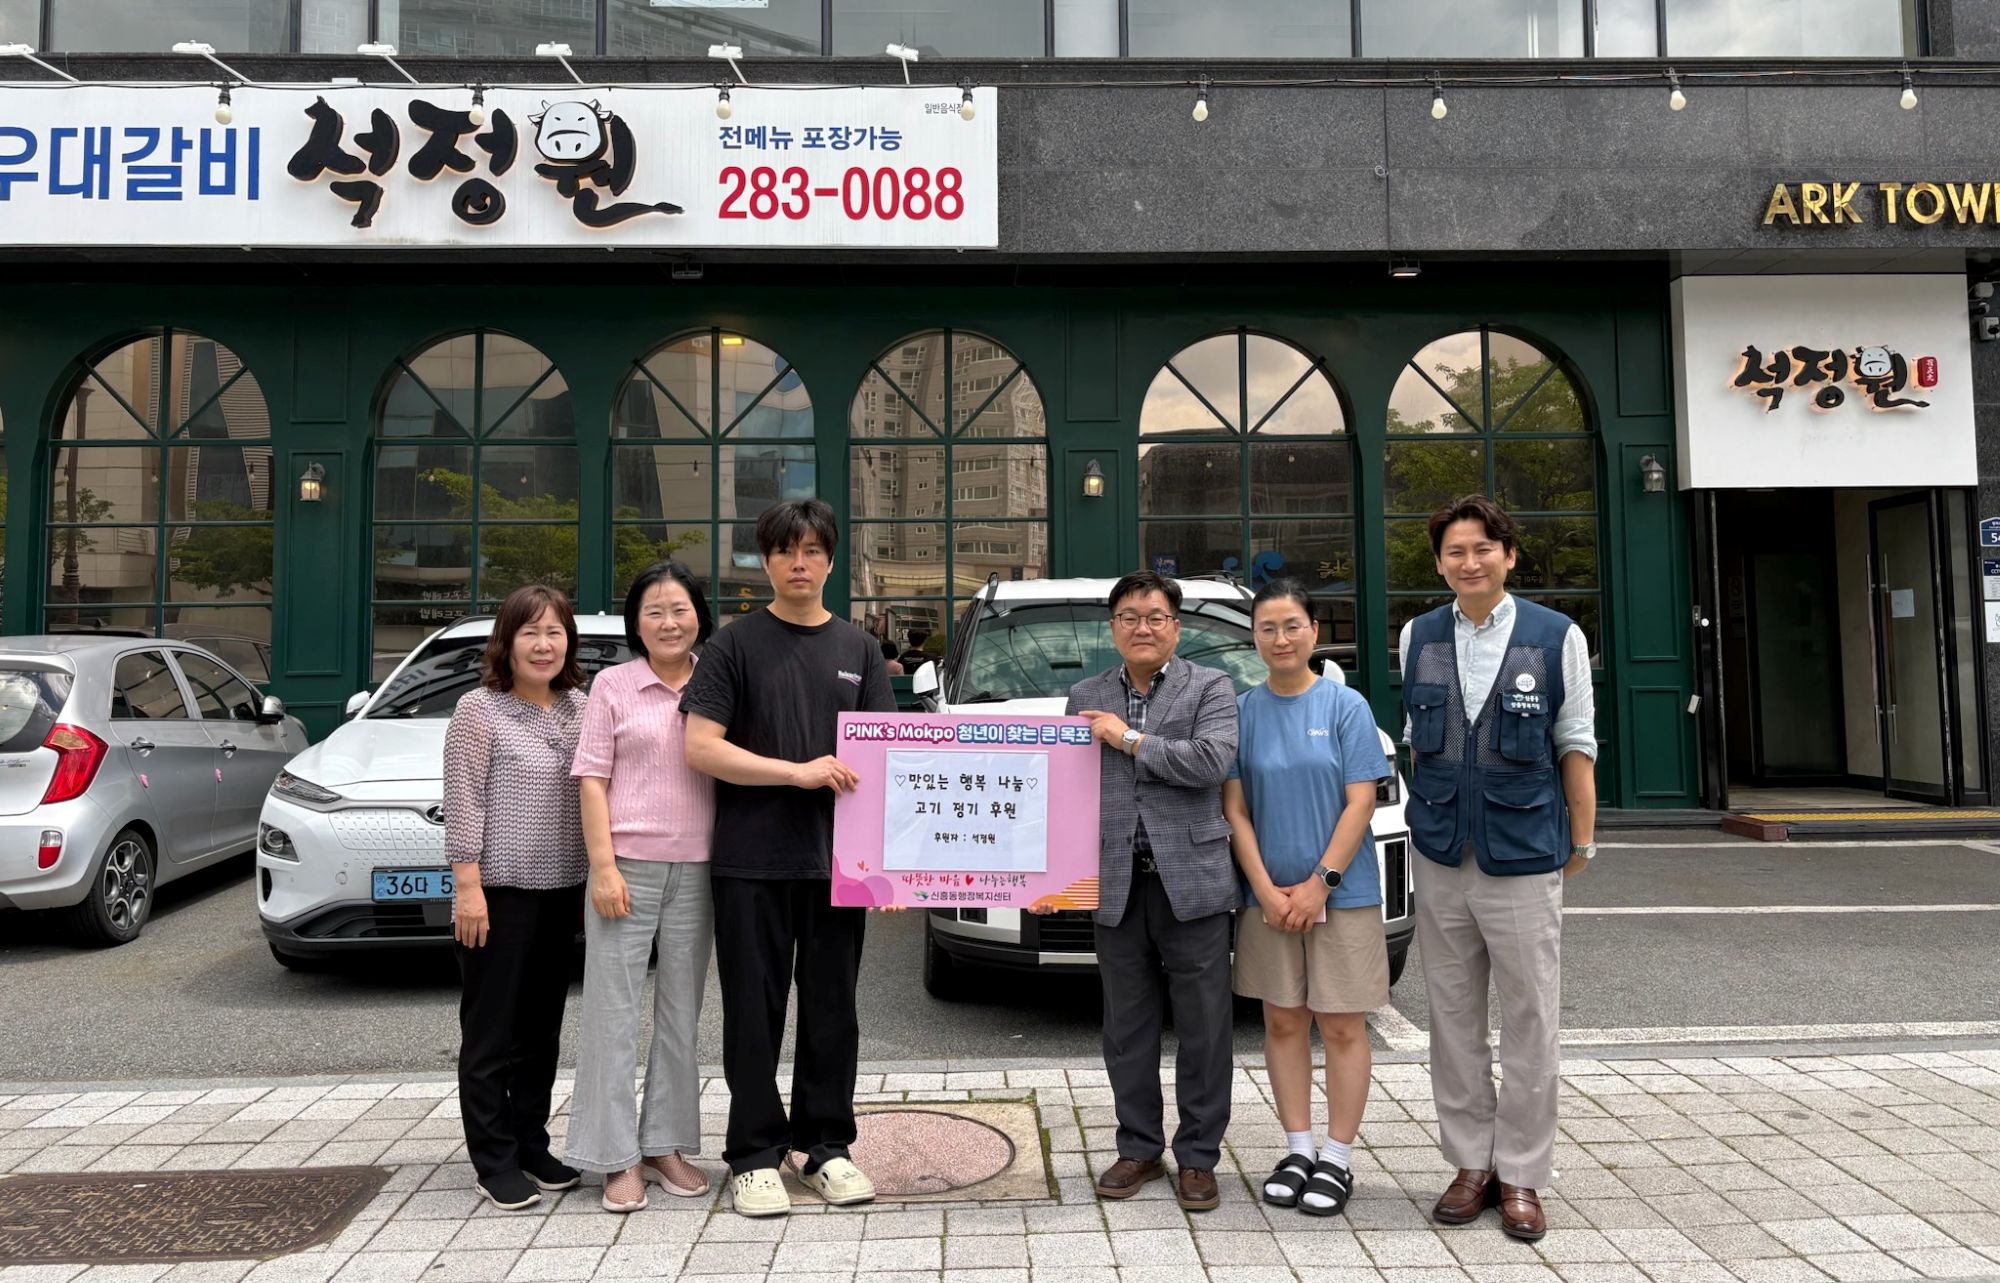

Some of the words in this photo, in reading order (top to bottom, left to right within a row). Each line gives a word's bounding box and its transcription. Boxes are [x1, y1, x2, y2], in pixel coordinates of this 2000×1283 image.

[719, 125, 794, 150] 전메뉴
[801, 125, 902, 151] 포장가능
[287, 95, 684, 229] 석정원
[718, 166, 965, 220] 283-0088
[1763, 182, 1863, 224] ARK
[1879, 182, 2000, 224] TOW
[1734, 345, 1930, 411] 석정원
[845, 723, 896, 740] PINK's
[899, 724, 955, 743] Mokpo
[957, 725, 1003, 743] 청년이
[1007, 726, 1038, 744] 찾는
[1040, 725, 1058, 744] 큰
[1060, 726, 1092, 745] 목포
[909, 774, 949, 790] 맛있는
[960, 774, 986, 791] 행복
[998, 776, 1023, 792] 나눔
[915, 801, 941, 815] 고기
[953, 802, 979, 818] 정기
[990, 802, 1016, 819] 후원
[934, 832, 958, 843] 후원자
[972, 833, 996, 844] 석정원
[902, 873, 934, 887] 따뜻한
[940, 874, 960, 887] 마음
[930, 891, 1011, 901] 신흥동행정복지센터
